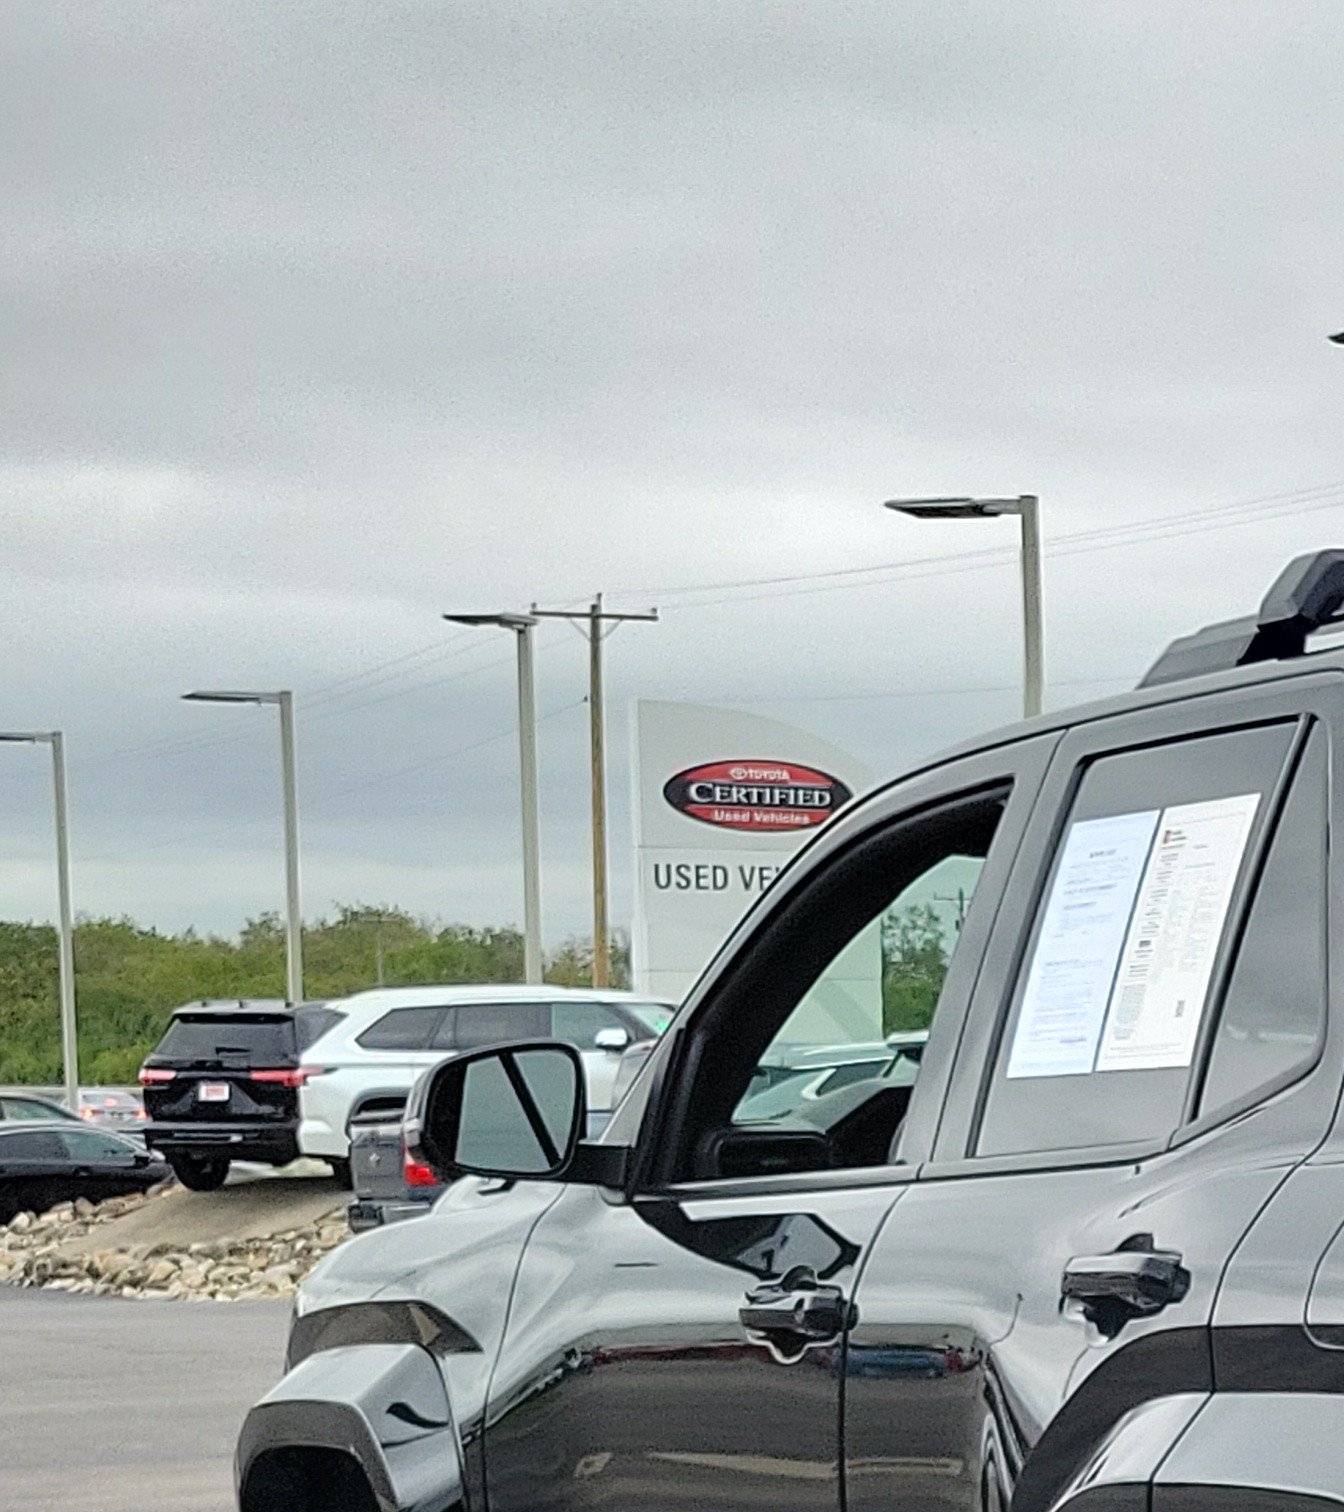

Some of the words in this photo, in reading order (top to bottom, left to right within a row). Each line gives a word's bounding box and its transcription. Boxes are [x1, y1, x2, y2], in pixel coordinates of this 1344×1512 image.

[748, 769, 790, 781] TOYOTA
[689, 783, 831, 807] CERTIFIED
[714, 810, 750, 822] Used
[754, 812, 810, 824] Vehicles
[654, 864, 728, 891] USED
